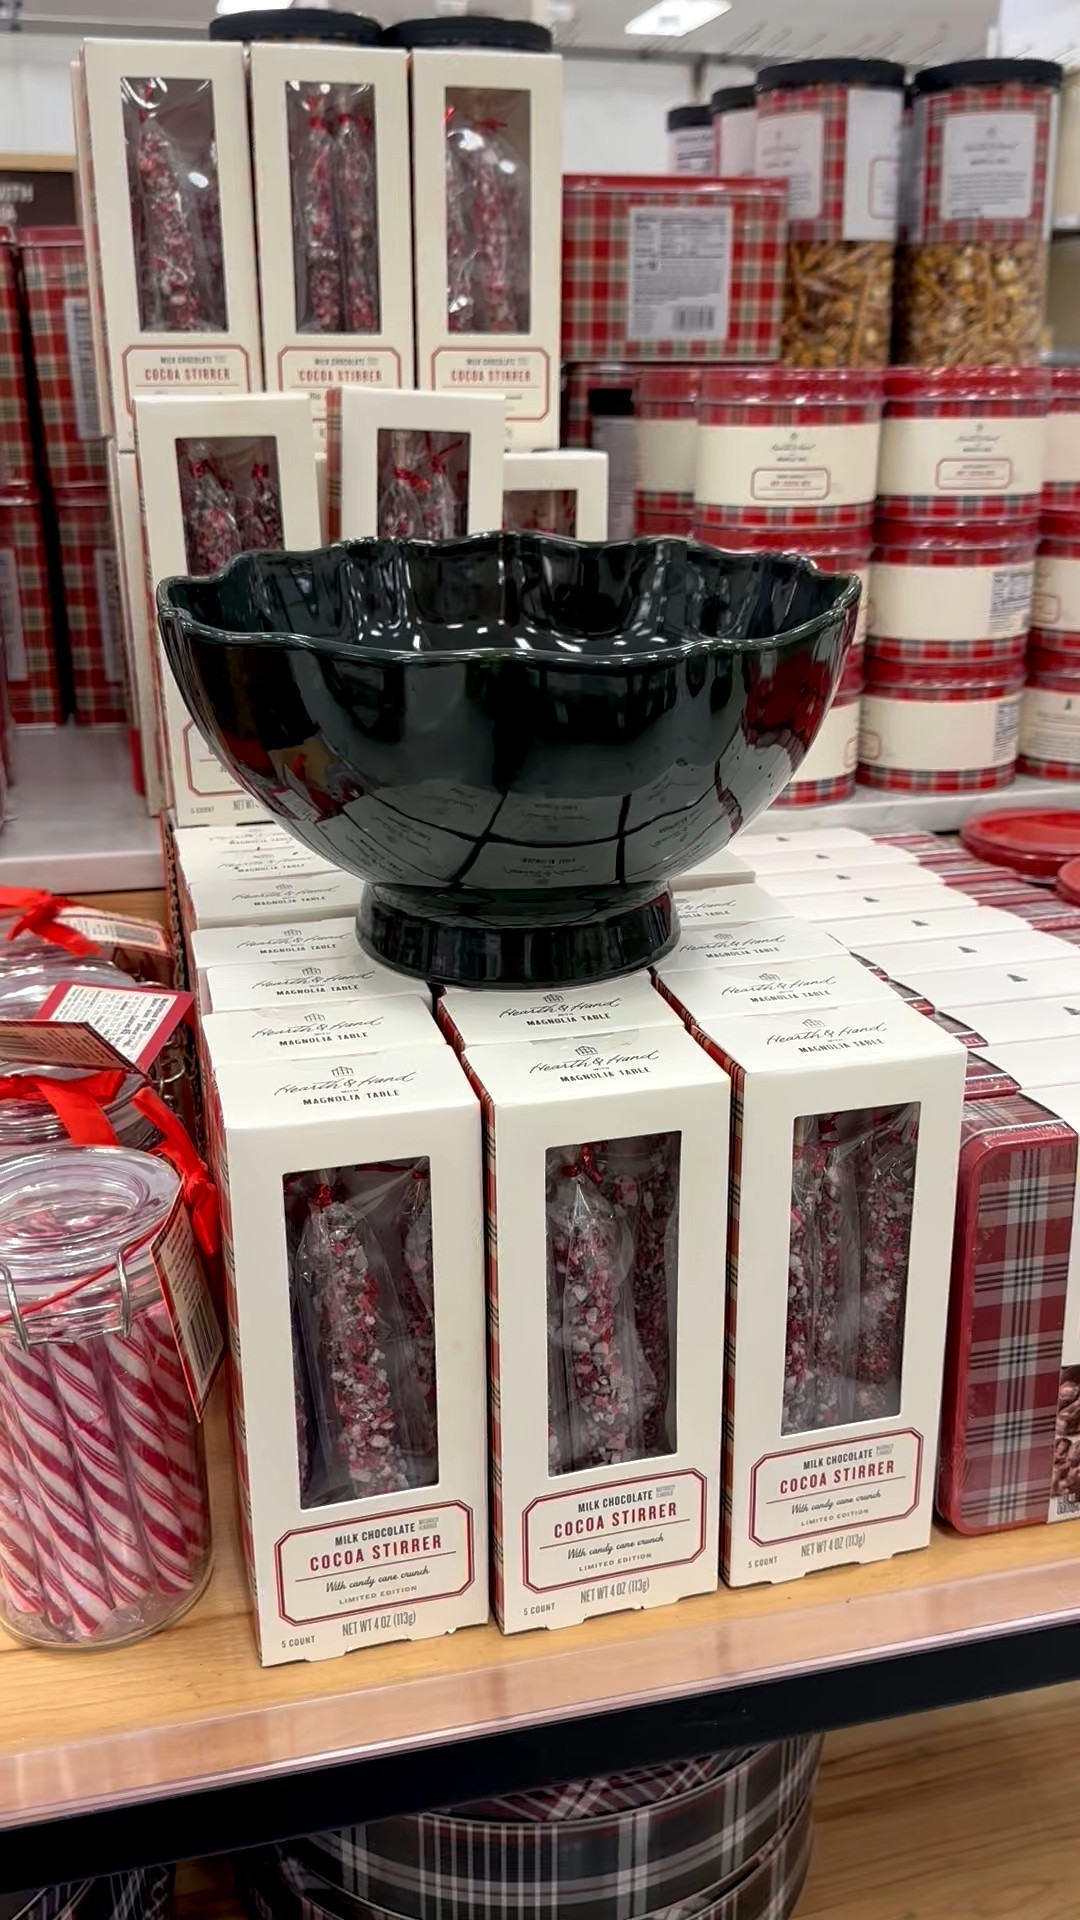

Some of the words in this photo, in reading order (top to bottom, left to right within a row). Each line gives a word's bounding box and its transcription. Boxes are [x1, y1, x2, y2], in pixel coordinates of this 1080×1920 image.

[144, 369, 180, 381] COCOA
[299, 370, 332, 381] COCOA
[451, 370, 483, 381] COCOA
[260, 946, 306, 954] MAGNOLIA
[706, 950, 750, 959] MAGNOLIA
[754, 946, 780, 954] TABLE
[276, 987, 325, 996] MAGNOLIA
[330, 984, 360, 992] TABLE
[750, 994, 800, 1003] MAGNOLIA
[802, 990, 831, 998] TABLE
[499, 1004, 557, 1018] Hearth
[570, 997, 622, 1012] Hand
[526, 1016, 578, 1026] MAGNOLIA
[580, 1012, 612, 1022] TABLE
[279, 1036, 333, 1047] MAGNOLIA
[337, 1032, 369, 1041] TABLE
[766, 1029, 823, 1046] Hearth
[838, 1021, 888, 1036] Hand
[798, 1042, 851, 1053] MAGNOLIA
[853, 1038, 885, 1048] TABLE
[529, 1057, 592, 1074] Hearth
[606, 1049, 659, 1065] Hand
[274, 1078, 343, 1096] Hearth
[357, 1071, 417, 1087] Hand
[560, 1071, 615, 1083] MAGNOLIA
[619, 1066, 652, 1076] TABLE
[303, 1094, 361, 1106] MAGNOLIA
[366, 1089, 401, 1100] TABLE
[803, 1456, 824, 1470] MILK
[826, 1449, 873, 1466] CHOCOLATE
[780, 1472, 827, 1494] COCOA
[833, 1460, 895, 1484] STIRRER
[578, 1499, 600, 1513] MILK
[602, 1490, 653, 1508] CHOCOLATE
[792, 1502, 809, 1515] With
[811, 1498, 834, 1512] candy
[836, 1497, 853, 1507] cane
[855, 1489, 881, 1502] crunch
[554, 1516, 605, 1539] COCOA
[612, 1502, 677, 1527] STIRRER
[801, 1515, 834, 1526] LIMITED
[837, 1508, 869, 1519] EDITION
[335, 1533, 359, 1546] MILK
[362, 1522, 416, 1542] CHOCOLATE
[309, 1548, 365, 1572] COCOA
[372, 1534, 442, 1560] STIRRER
[567, 1544, 587, 1560] With
[589, 1542, 613, 1556] candy
[616, 1540, 635, 1550] cane
[637, 1533, 664, 1547] crunch
[801, 1543, 816, 1558] NET
[816, 1541, 828, 1555] WT
[829, 1539, 834, 1552] 4
[835, 1537, 844, 1551] OZ
[845, 1532, 866, 1549] (113g)
[579, 1560, 615, 1571] LIMITED
[617, 1552, 652, 1564] EDITION
[754, 1556, 778, 1567] COUNT
[325, 1577, 347, 1593] With
[349, 1573, 375, 1588] candy
[378, 1573, 398, 1583] cane
[401, 1565, 431, 1580] crunch
[338, 1592, 377, 1605] LIMITED
[380, 1585, 417, 1597] EDITION
[580, 1589, 596, 1604] NET
[597, 1586, 609, 1601] WT
[610, 1585, 616, 1598] 4
[616, 1582, 626, 1597] OZ
[628, 1577, 650, 1595] (113g)
[523, 1608, 528, 1616] 5
[530, 1602, 555, 1615] COUNT
[342, 1620, 359, 1637] NET
[360, 1618, 374, 1634] WT
[374, 1617, 380, 1631] 4
[381, 1614, 391, 1629] OZ
[393, 1610, 417, 1627] (113g)
[281, 1641, 287, 1649] 5
[289, 1635, 316, 1648] COUNT
